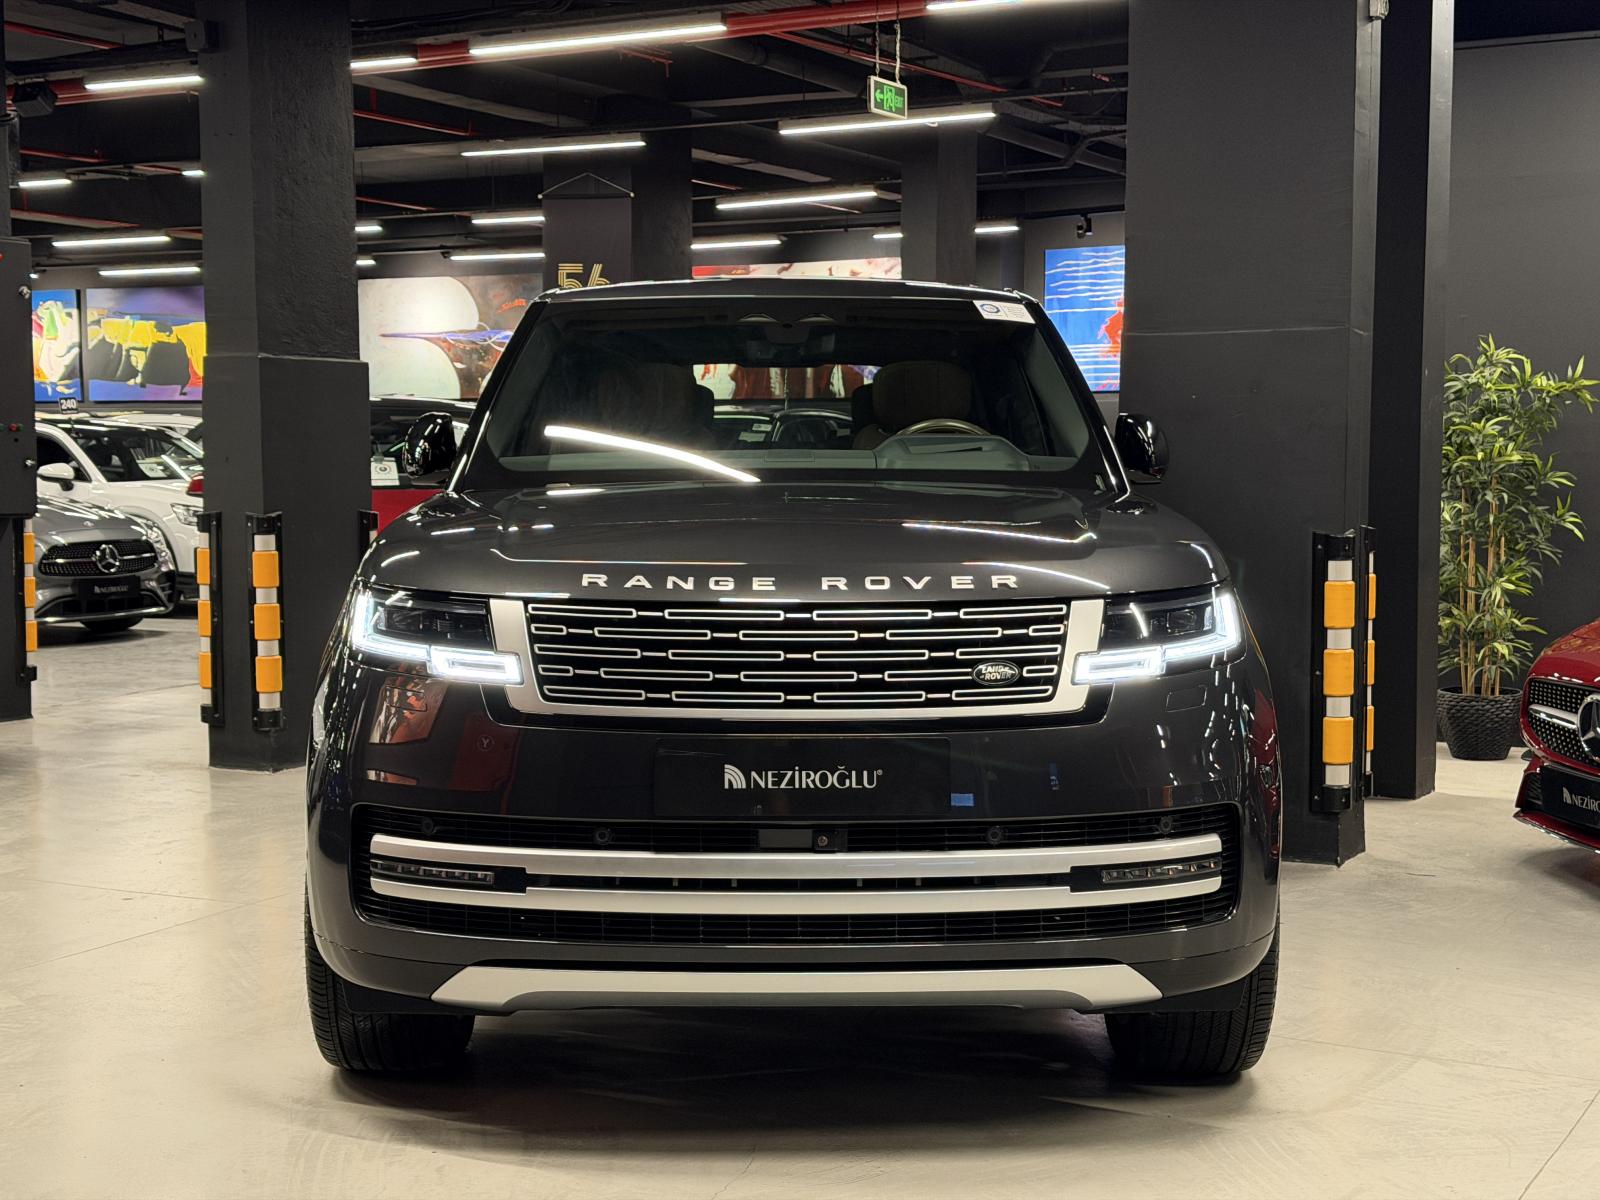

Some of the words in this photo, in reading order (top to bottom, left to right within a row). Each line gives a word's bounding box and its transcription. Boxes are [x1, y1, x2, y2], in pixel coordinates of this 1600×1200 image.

[895, 95, 904, 107] EXIT
[61, 399, 77, 410] 240
[581, 573, 776, 591] RANGE
[821, 574, 1019, 591] ROVER
[984, 672, 1012, 680] ROVER
